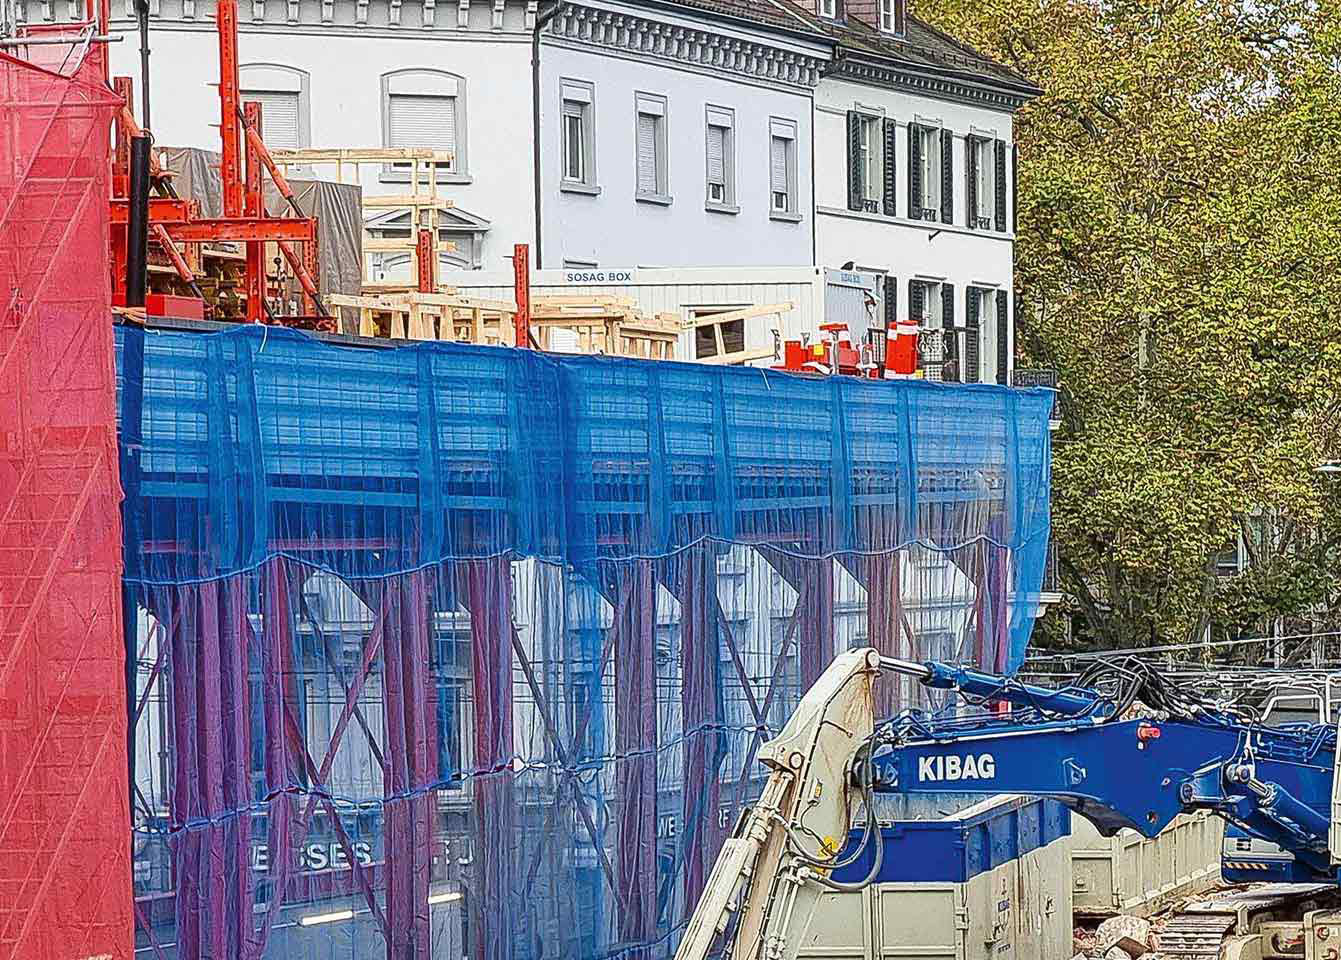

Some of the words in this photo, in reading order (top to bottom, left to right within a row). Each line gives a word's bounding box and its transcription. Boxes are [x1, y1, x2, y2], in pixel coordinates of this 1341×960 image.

[567, 273, 605, 282] SOSAG
[608, 272, 631, 281] BOX
[918, 753, 995, 781] KIBAG
